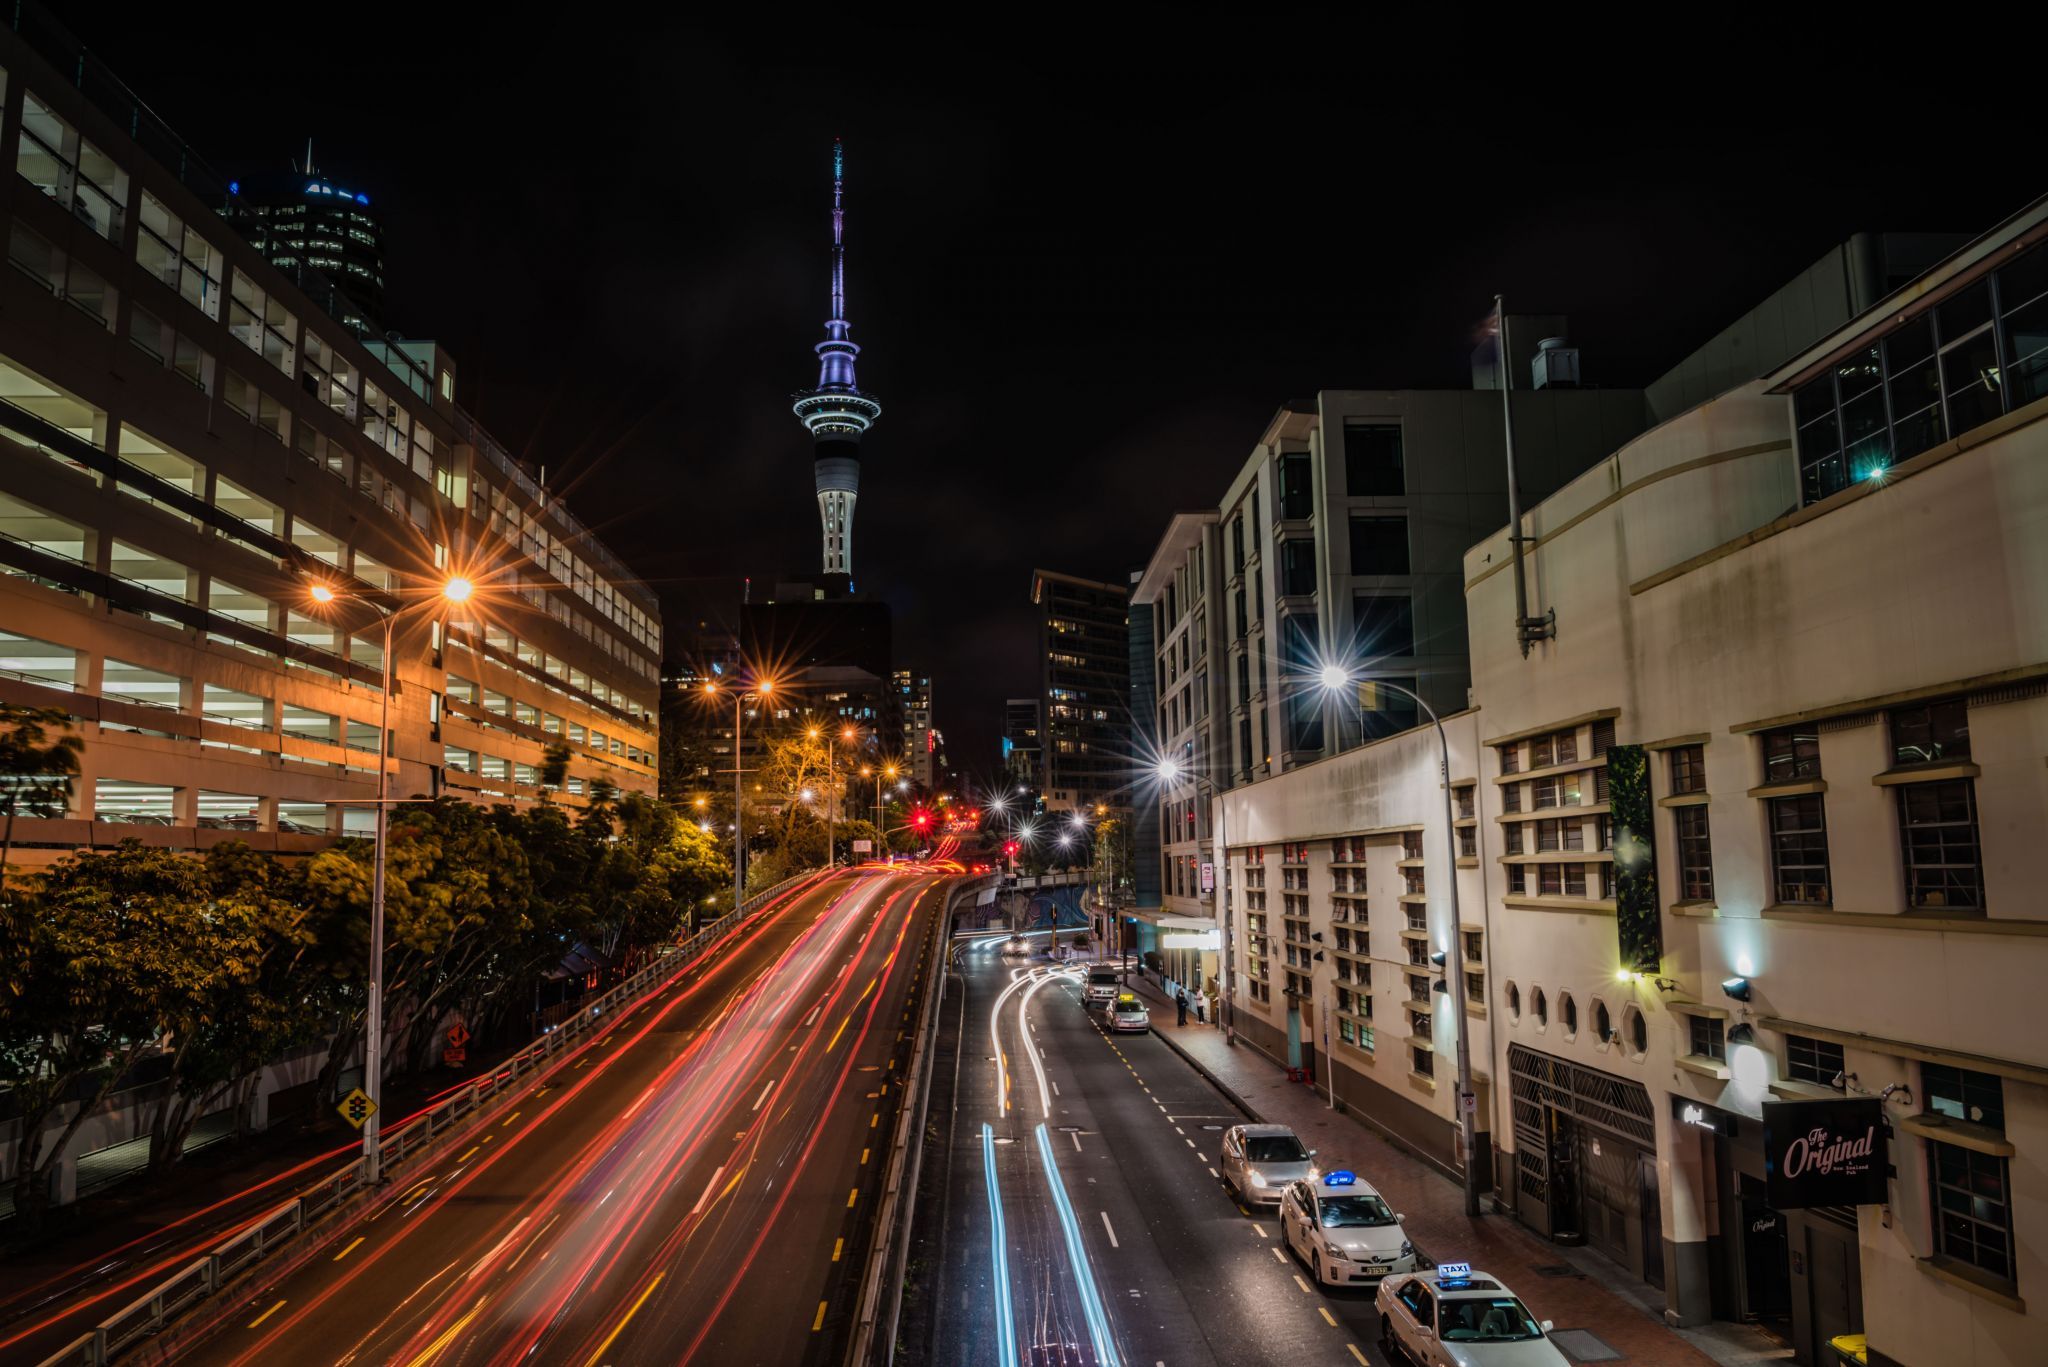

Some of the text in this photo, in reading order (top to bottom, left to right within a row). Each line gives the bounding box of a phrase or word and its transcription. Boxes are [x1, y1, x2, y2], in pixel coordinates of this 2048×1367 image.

[1808, 1127, 1828, 1146] The
[1783, 1126, 1874, 1178] Original
[1443, 1265, 1468, 1273] TAXI
